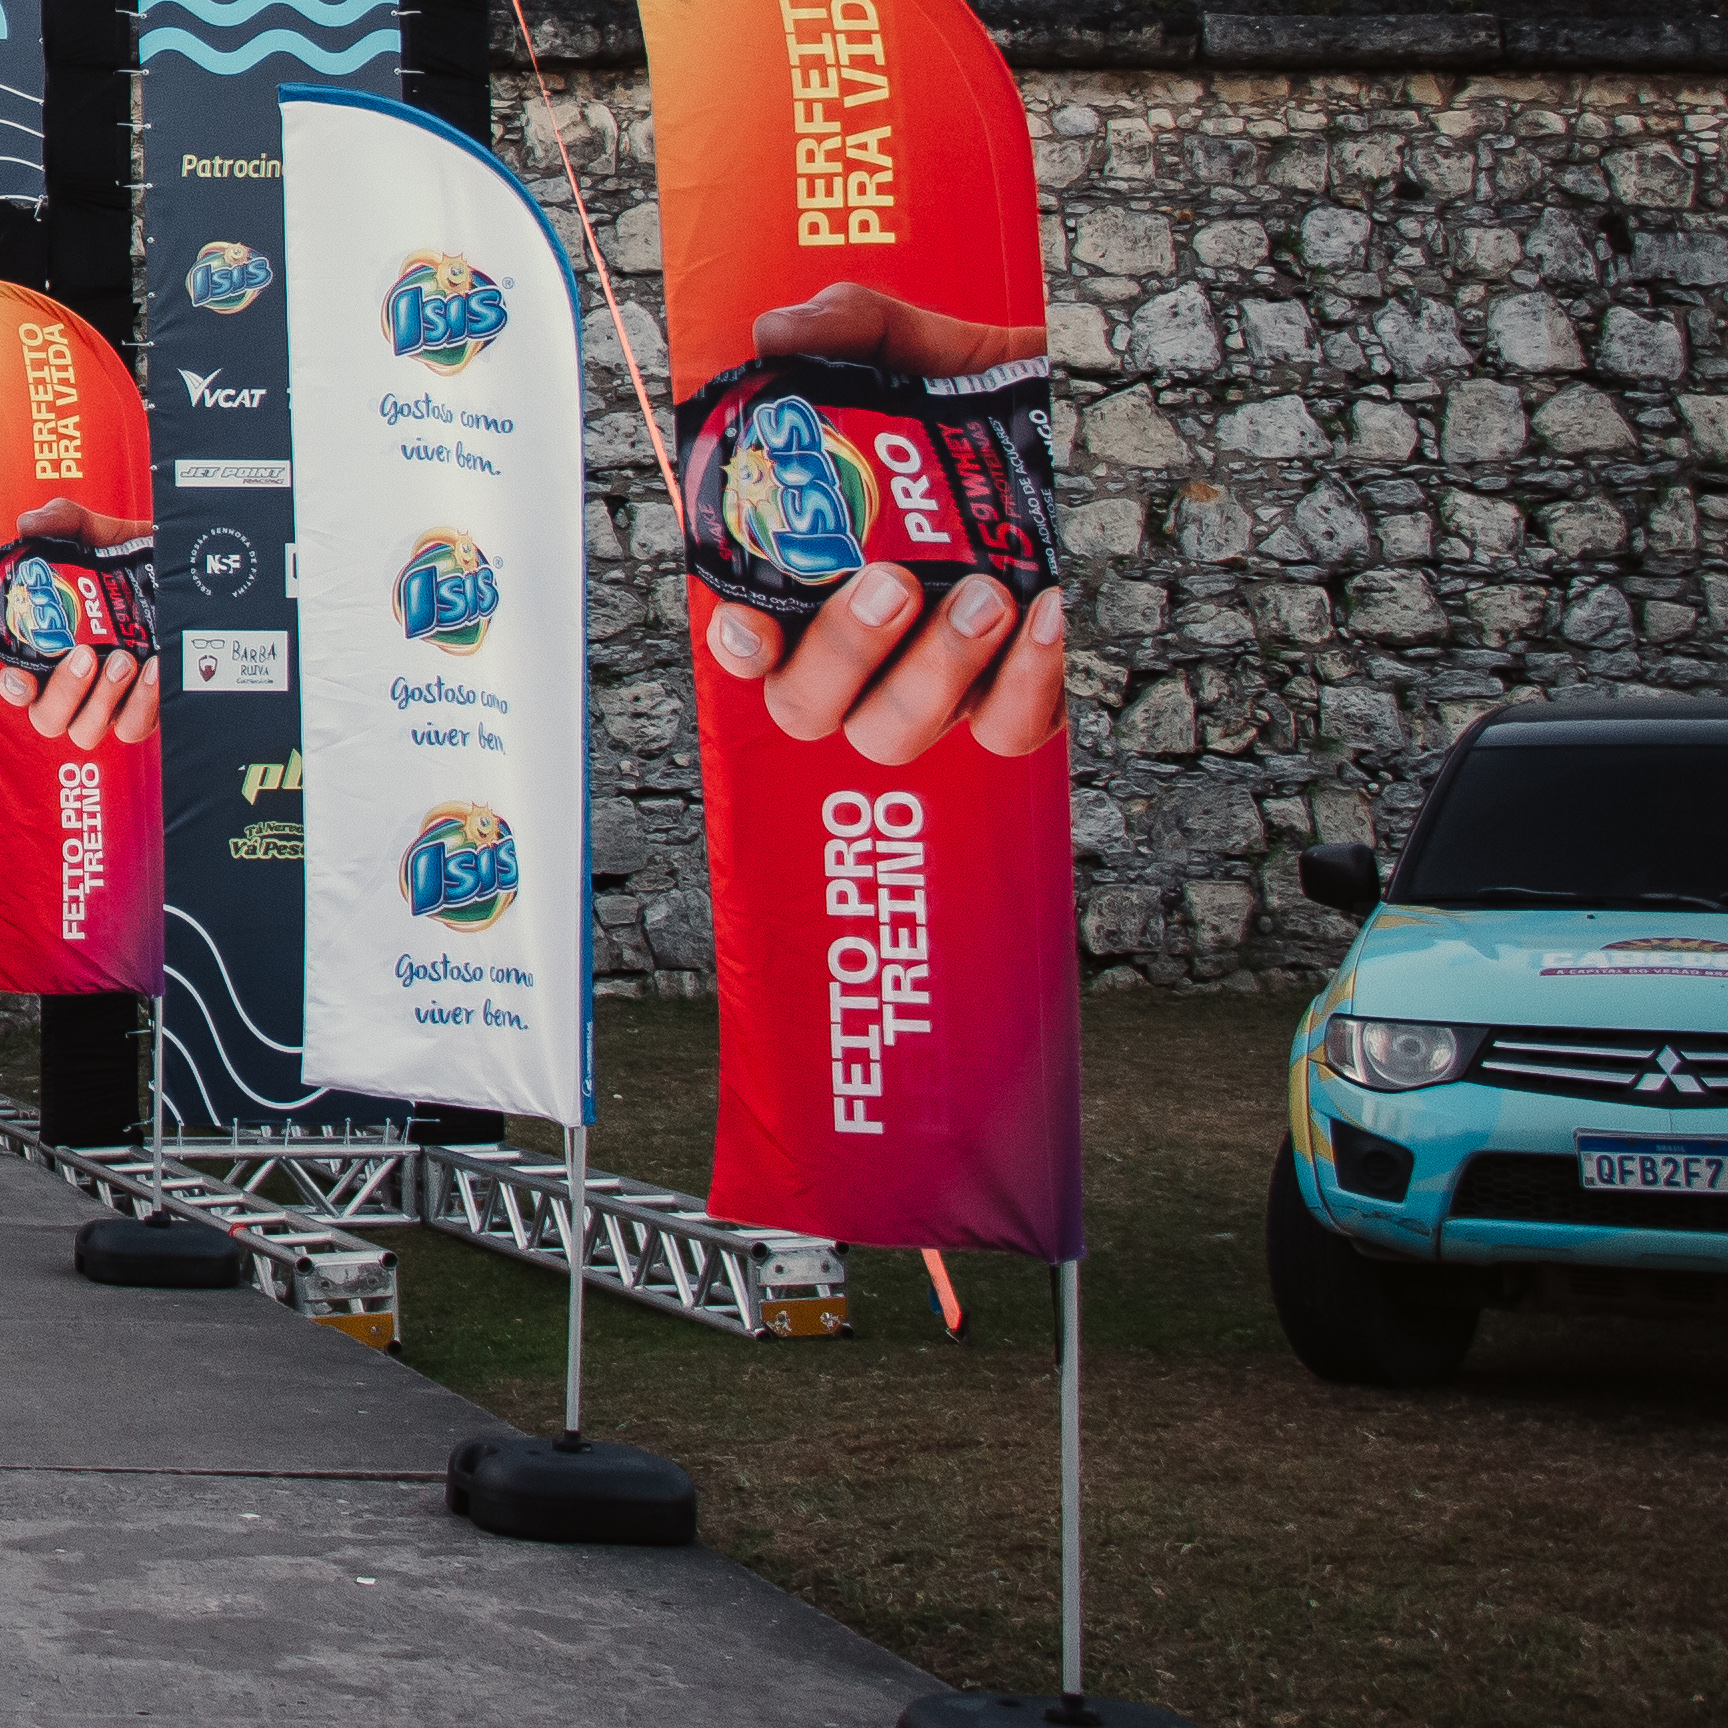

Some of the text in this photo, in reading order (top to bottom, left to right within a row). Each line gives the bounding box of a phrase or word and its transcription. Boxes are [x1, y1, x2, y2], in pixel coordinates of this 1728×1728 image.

[181, 153, 282, 178] Patrocin
[846, 126, 896, 244] PRA
[19, 322, 59, 480] PERFEITO
[43, 323, 84, 479] PRA VIDA
[204, 388, 267, 408] VCAT
[379, 392, 453, 426] Gostoso
[874, 432, 951, 543] PRO
[1018, 477, 1035, 495] DE
[78, 576, 108, 635] PRO
[232, 640, 277, 663] BARBA
[240, 665, 269, 676] RUIVA
[390, 675, 476, 709] Gostoso
[411, 722, 470, 746] viver
[81, 762, 105, 894] TREINO
[59, 762, 85, 940] FEITO PRO
[873, 791, 931, 1047] TREINO
[395, 953, 483, 987] Gostoso
[822, 790, 884, 1134] FEITO PRO
[415, 1000, 475, 1026] viver
[1595, 1154, 1724, 1189] QFB2F7
